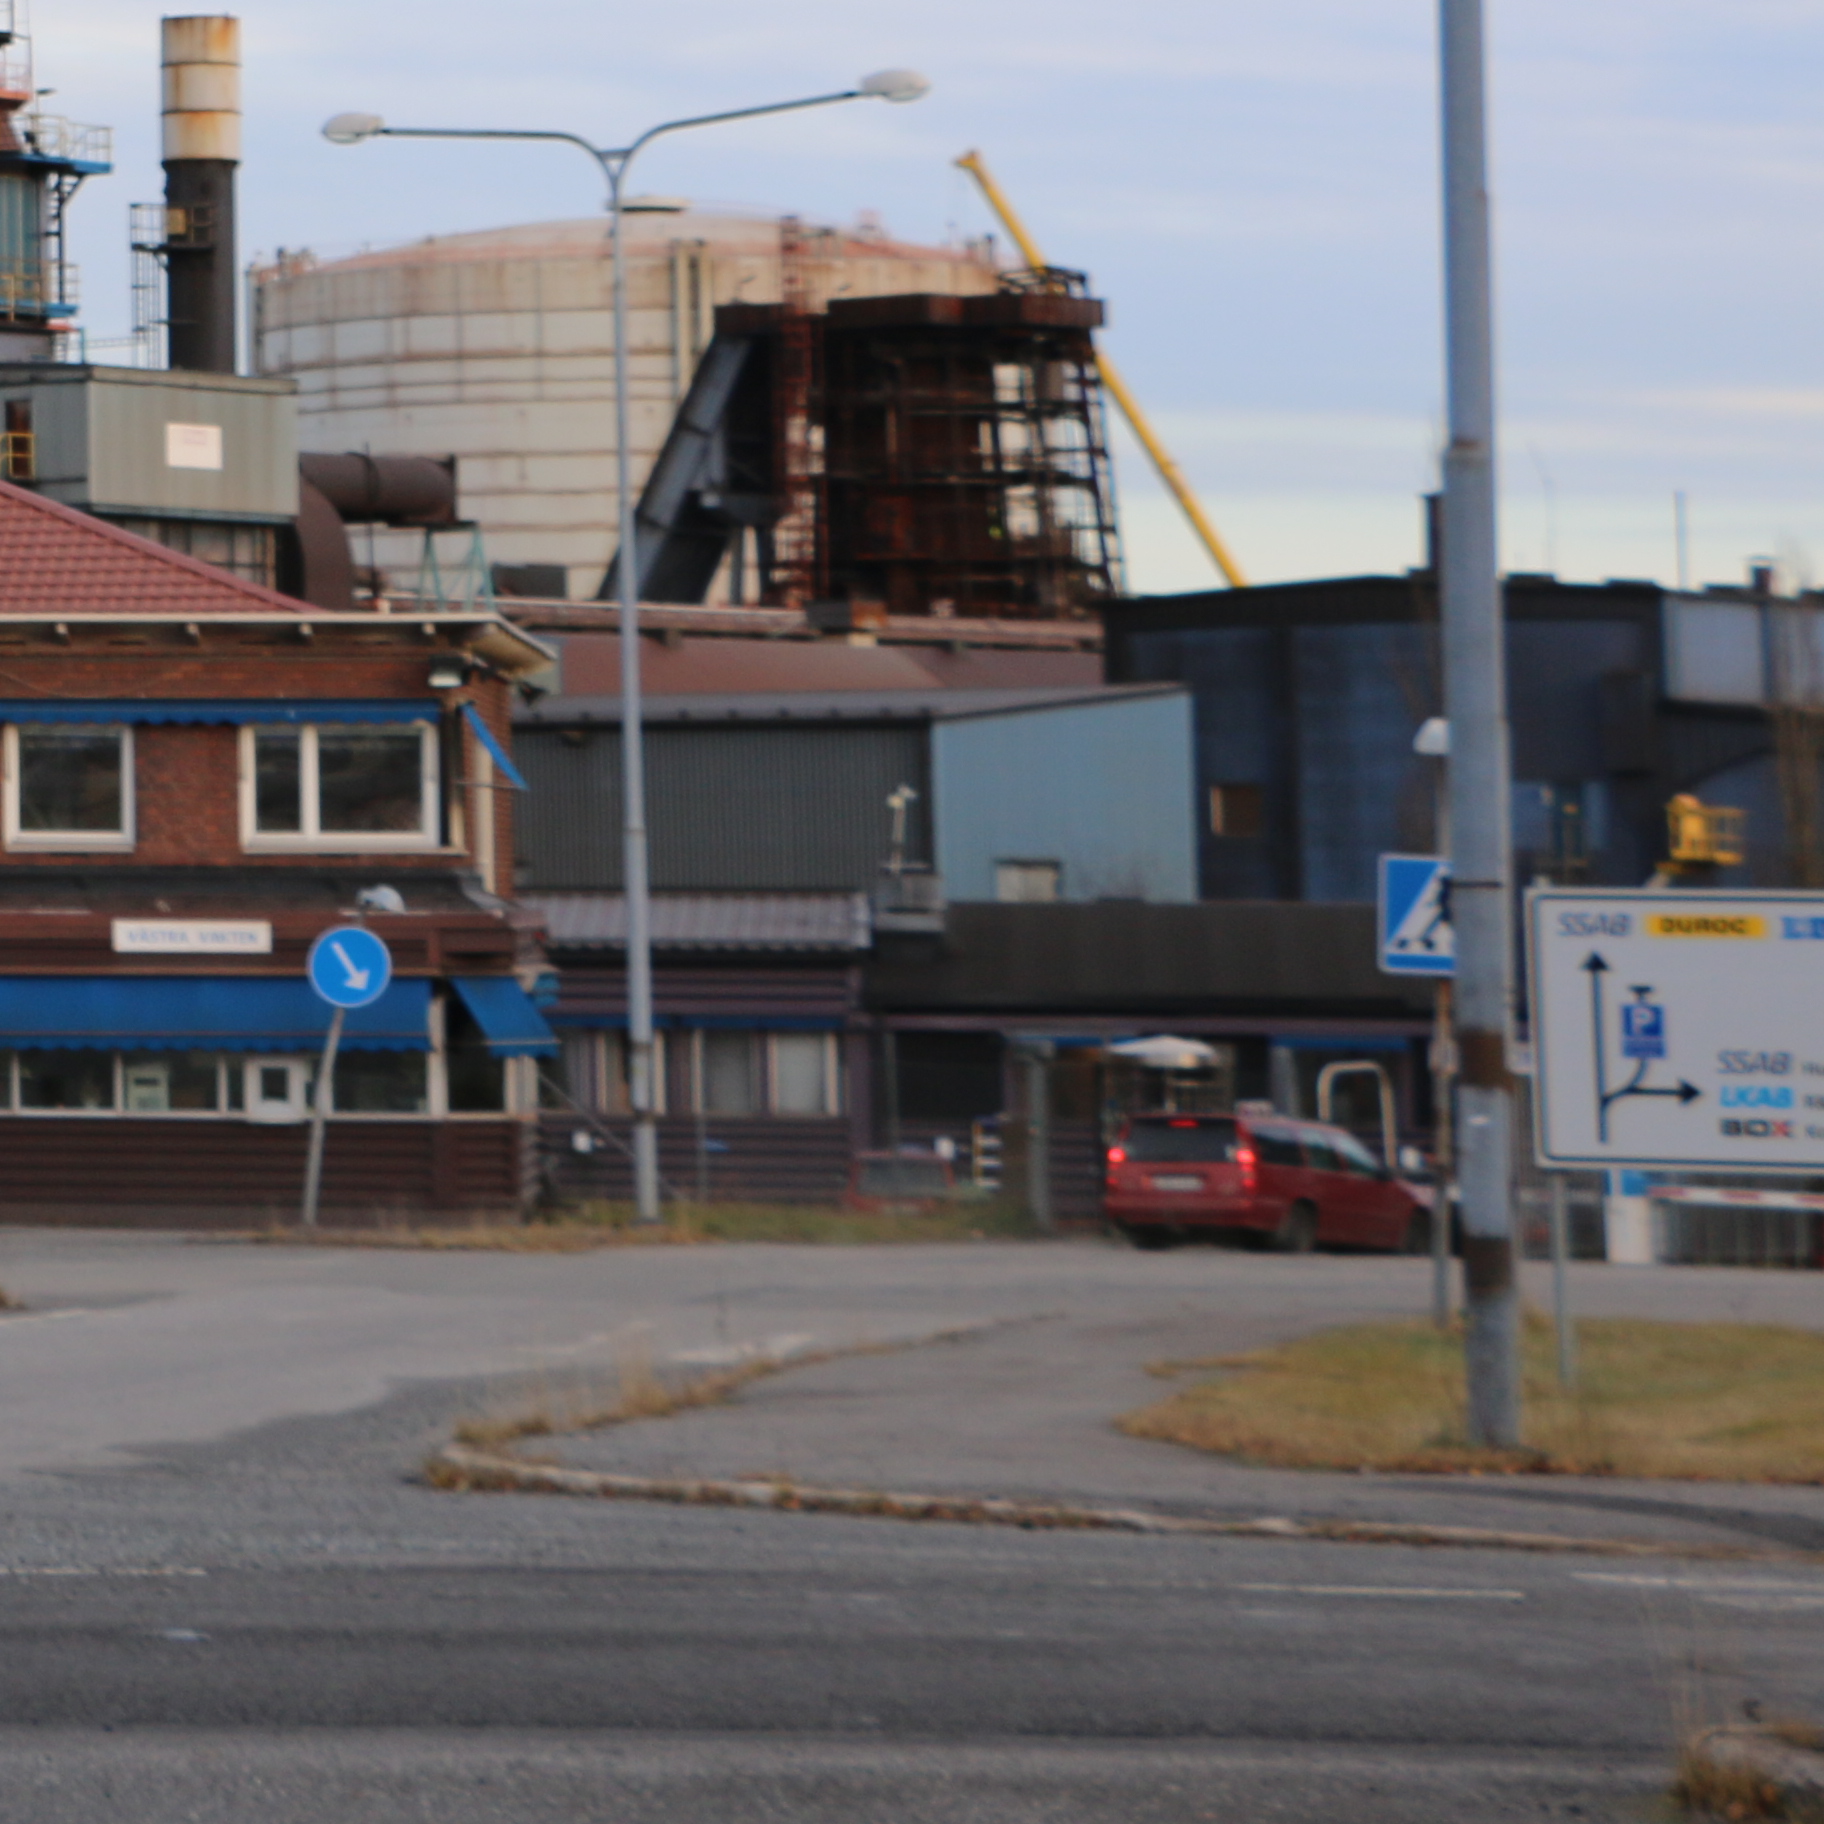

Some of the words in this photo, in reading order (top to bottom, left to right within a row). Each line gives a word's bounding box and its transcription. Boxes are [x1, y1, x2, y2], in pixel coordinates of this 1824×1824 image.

[1558, 911, 1632, 937] SSAB
[1661, 916, 1747, 935] DUROC
[1717, 1049, 1793, 1075] SSAB
[1720, 1085, 1794, 1109] LKAB
[1720, 1118, 1795, 1137] BOX
